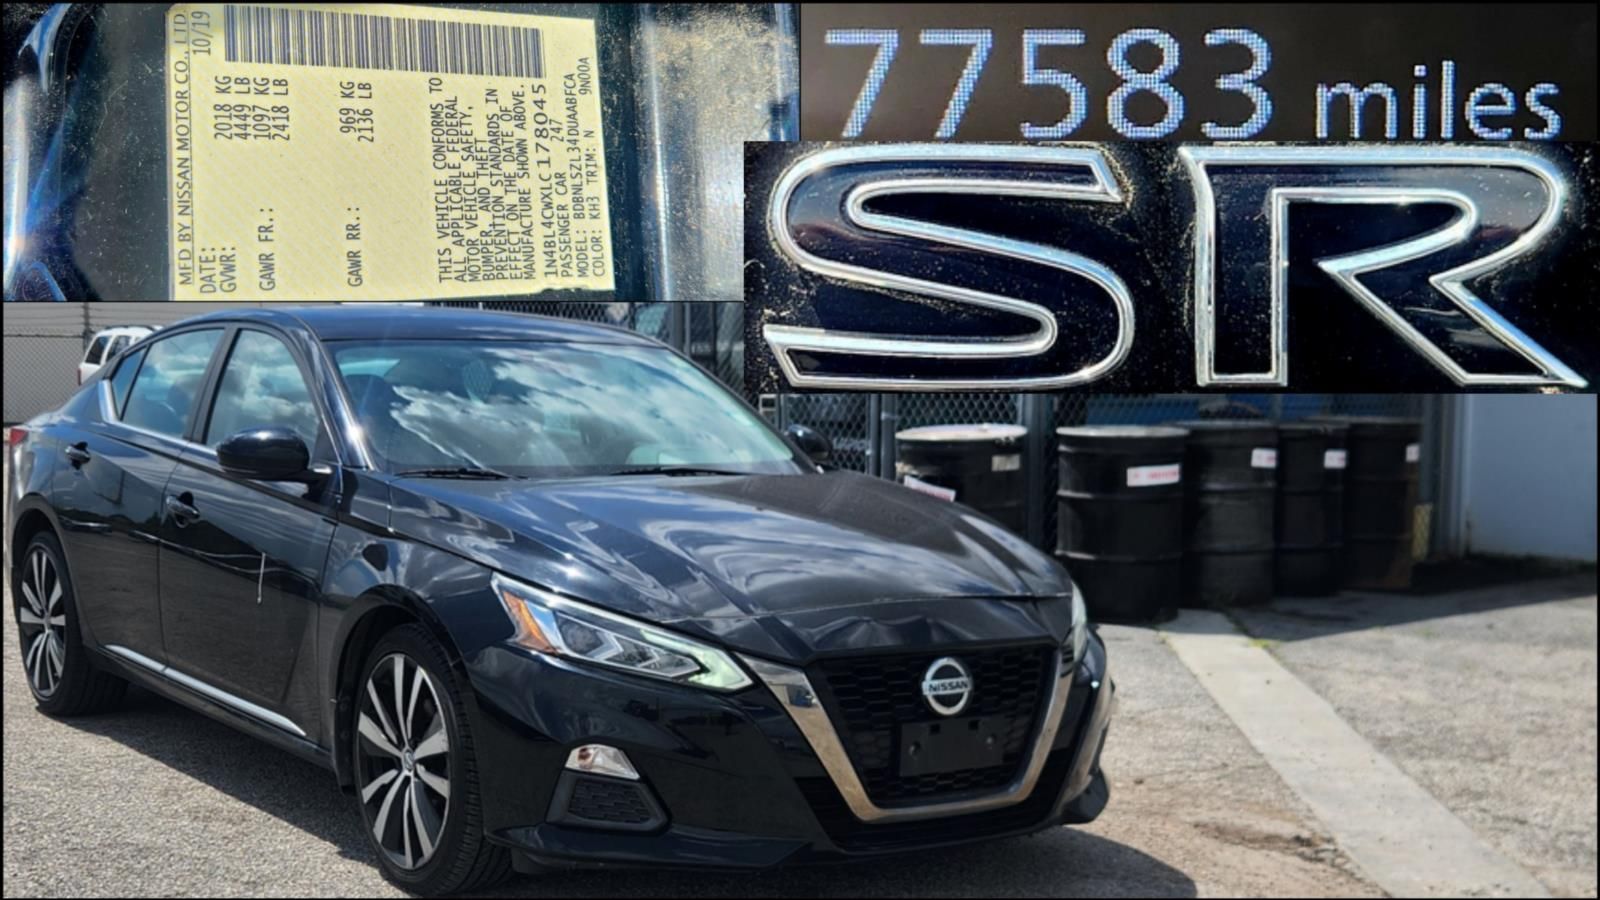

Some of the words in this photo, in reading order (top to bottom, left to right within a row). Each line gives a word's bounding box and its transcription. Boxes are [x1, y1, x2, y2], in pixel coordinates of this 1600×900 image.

[173, 10, 186, 44] LTD.
[192, 10, 214, 56] 10/19
[174, 51, 189, 84] CO.,
[215, 76, 231, 94] KG
[235, 77, 250, 94] LB
[429, 78, 443, 93] TO
[825, 28, 1274, 139] 77583
[1316, 60, 1562, 139] miles
[254, 77, 270, 95] KG
[274, 79, 288, 96] LB
[340, 81, 354, 98] KG
[358, 83, 372, 99] LB
[486, 89, 498, 103] IN
[175, 90, 190, 151] MOTOR
[214, 103, 232, 140] 2018
[234, 104, 252, 140] 4449
[253, 105, 271, 140] 1097
[272, 106, 290, 141] 2418
[339, 108, 356, 133] 969
[357, 108, 374, 142] 2136
[445, 96, 459, 152] FEDERAL
[500, 106, 513, 121] OF
[512, 85, 526, 130] ABOVE.
[431, 103, 447, 170] CONFORMS
[460, 106, 475, 161] SAFETY,
[502, 131, 516, 162] DATE
[550, 119, 564, 142] 247
[584, 130, 595, 138] N
[475, 138, 489, 179] THEFT
[487, 114, 504, 186] STANDARDS
[516, 139, 530, 179] SHOWN
[585, 148, 597, 185] TRIM:
[176, 157, 190, 216] NISSAN
[463, 172, 478, 230] VEHICLE
[478, 187, 491, 212] AND
[504, 172, 517, 195] THE
[555, 172, 567, 195] CAR
[435, 180, 450, 239] VEHICLE
[448, 162, 465, 247] APPLICABLE
[506, 204, 519, 221] ON
[587, 196, 600, 219] KH3
[177, 223, 191, 242] BY
[258, 208, 274, 242] FR.:
[346, 207, 360, 240] RR.:
[492, 195, 508, 280] PREVENTION
[520, 188, 536, 280] MANUFACTURE
[559, 204, 573, 278] PASSENGER
[179, 249, 192, 285] MFD
[199, 247, 216, 293] DATE:
[220, 246, 236, 292] GVWR:
[347, 250, 362, 287] GAWR
[438, 248, 452, 282] THIS
[454, 257, 467, 282] ALL
[467, 239, 481, 282] MOTOR
[480, 223, 495, 281] BUMPER,
[508, 230, 523, 279] EFFECT
[576, 230, 589, 278] MODEL:
[591, 230, 605, 277] COLOR:
[763, 145, 1588, 389] SR
[259, 253, 276, 291] GAWR
[928, 681, 968, 692] NISSAN
